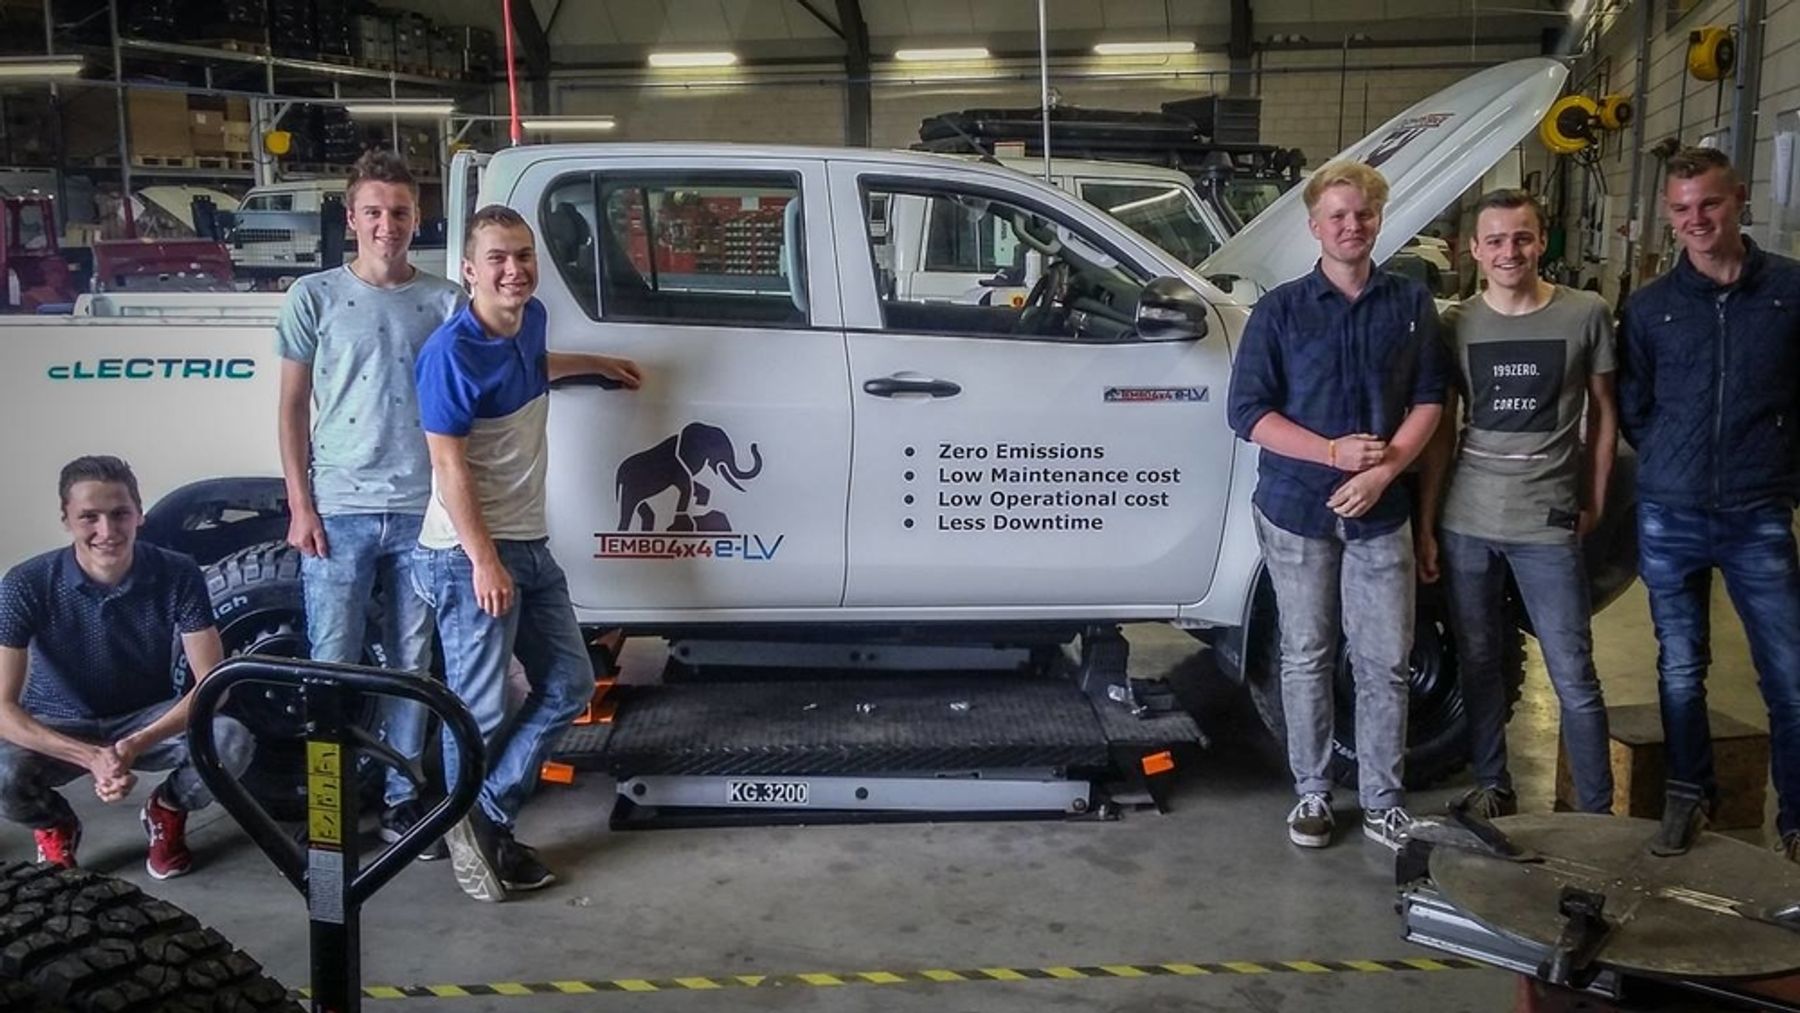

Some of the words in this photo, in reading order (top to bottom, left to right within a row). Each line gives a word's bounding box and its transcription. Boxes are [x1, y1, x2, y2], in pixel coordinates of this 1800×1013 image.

[939, 444, 988, 459] Zero
[996, 443, 1105, 459] Emissions
[939, 468, 983, 483] Low
[991, 467, 1129, 483] Maintenance
[1136, 468, 1181, 483] cost
[938, 491, 982, 507] Low
[990, 491, 1117, 509] Operational
[1124, 492, 1169, 507] cost
[938, 515, 986, 530] Less
[993, 514, 1103, 530] Downtime
[729, 782, 807, 802] KG.3200
